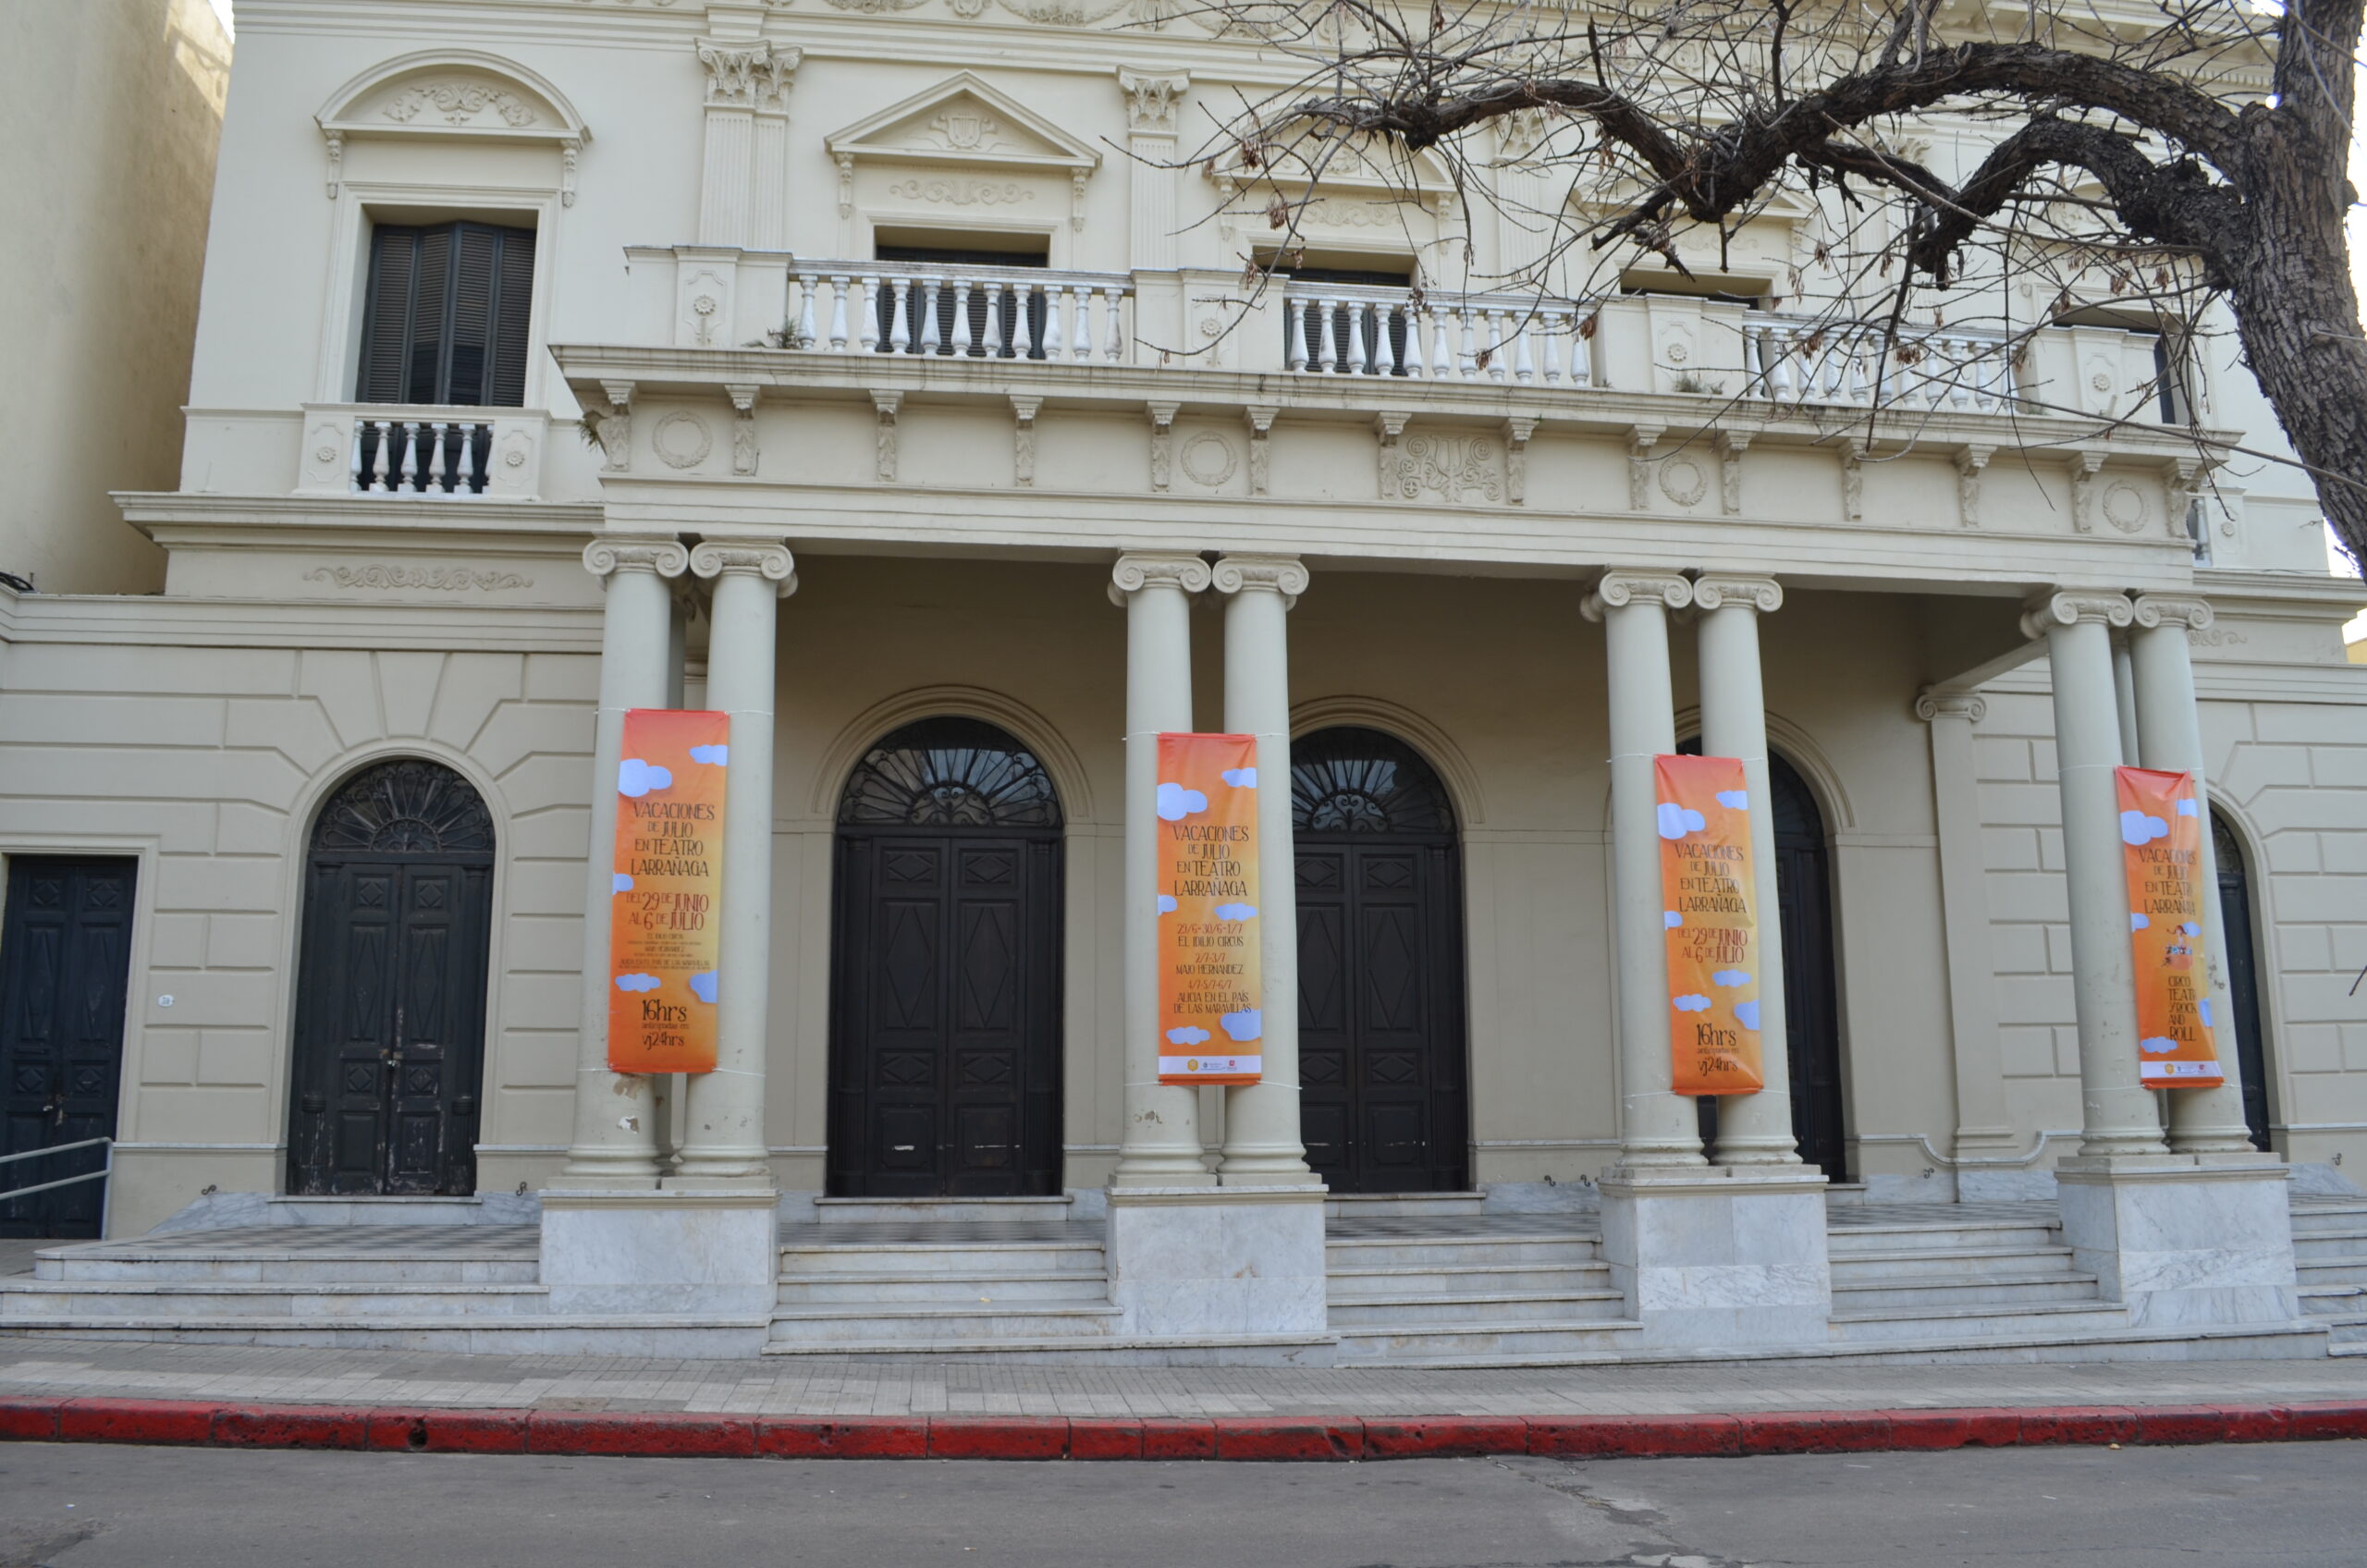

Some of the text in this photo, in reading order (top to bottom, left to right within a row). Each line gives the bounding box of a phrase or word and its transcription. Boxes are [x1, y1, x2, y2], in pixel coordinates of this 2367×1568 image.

[633, 802, 715, 820] VACACIONES
[647, 821, 693, 838] DE JULIO
[1173, 825, 1249, 841] VACACIONES
[634, 839, 704, 856] EN TEATRO
[1188, 843, 1230, 860] DE JULIO
[1674, 843, 1744, 861] VACACIONES
[631, 856, 709, 876] LARRAÑAGA
[1177, 861, 1241, 876] EN TEATRO
[1704, 861, 1730, 876] JULIO
[1174, 877, 1247, 896] LARRAÑAGA
[1680, 877, 1740, 894] EN TEATRO
[642, 892, 659, 911] 29
[661, 893, 673, 903] DE
[673, 893, 709, 913] JUNIO
[1679, 893, 1747, 913] LARRAÑAGA
[629, 912, 704, 931] AL 6 DE JULIO
[1178, 936, 1189, 947] EL
[1217, 936, 1244, 947] CIRCUS
[1693, 927, 1708, 945] 29
[1719, 928, 1748, 946] JUNIO
[1681, 946, 1694, 958] AL
[1696, 946, 1703, 963] 6
[1716, 946, 1744, 963] JULIO
[2168, 976, 2191, 986] CIRCO
[1178, 992, 1202, 1002] ALICIA
[1205, 992, 1216, 1002] EN
[1218, 992, 1229, 1002] EL
[642, 998, 687, 1022] 16hrs
[1173, 1003, 1252, 1013] DE LAS MARAVILLAS
[1697, 1023, 1736, 1046] 16hrs
[2169, 1026, 2197, 1042] ROLL
